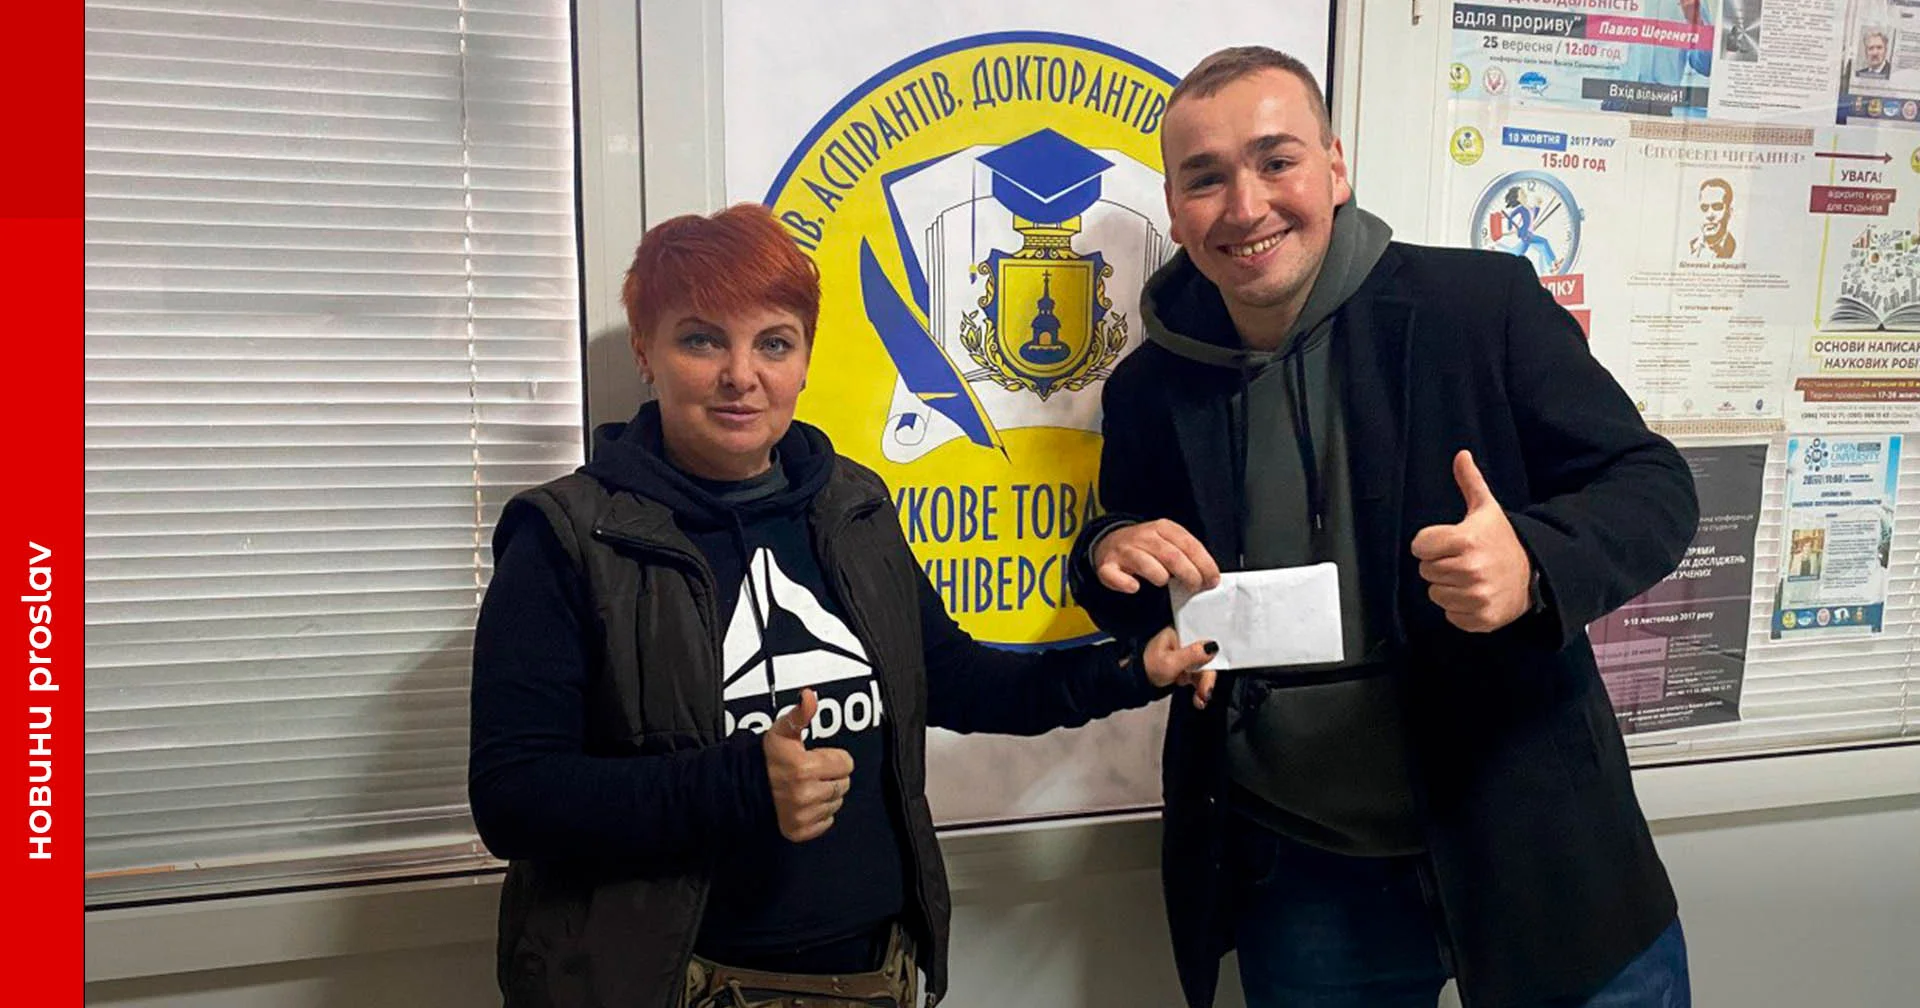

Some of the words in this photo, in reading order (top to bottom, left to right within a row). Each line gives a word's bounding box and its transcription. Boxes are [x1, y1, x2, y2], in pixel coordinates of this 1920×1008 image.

[1600, 21, 1639, 38] Павло
[1483, 36, 1499, 49] 25
[1502, 40, 1553, 55] вересня
[1565, 43, 1598, 57] 12:00
[1600, 47, 1621, 61] год
[1609, 83, 1635, 100] Вхід
[801, 71, 964, 213] АСПІРАНТІВ,
[1520, 133, 1561, 145] ЖОВТНЯ
[1570, 135, 1591, 146] 2017
[1592, 137, 1616, 147] РОКУ
[1541, 153, 1579, 169] 15:00
[1582, 156, 1606, 172] год
[1841, 169, 1882, 184] УВАГА!
[1826, 203, 1842, 212] для
[780, 210, 825, 252] ІВ,
[1814, 341, 1866, 353] ОСНОВИ
[1824, 357, 1888, 369] НАУКОВИХ
[1011, 482, 1097, 541] ТОВА
[1679, 568, 1712, 579] УЧЕНИХ
[1680, 611, 1696, 620] 2017
[724, 679, 884, 740] ebo
